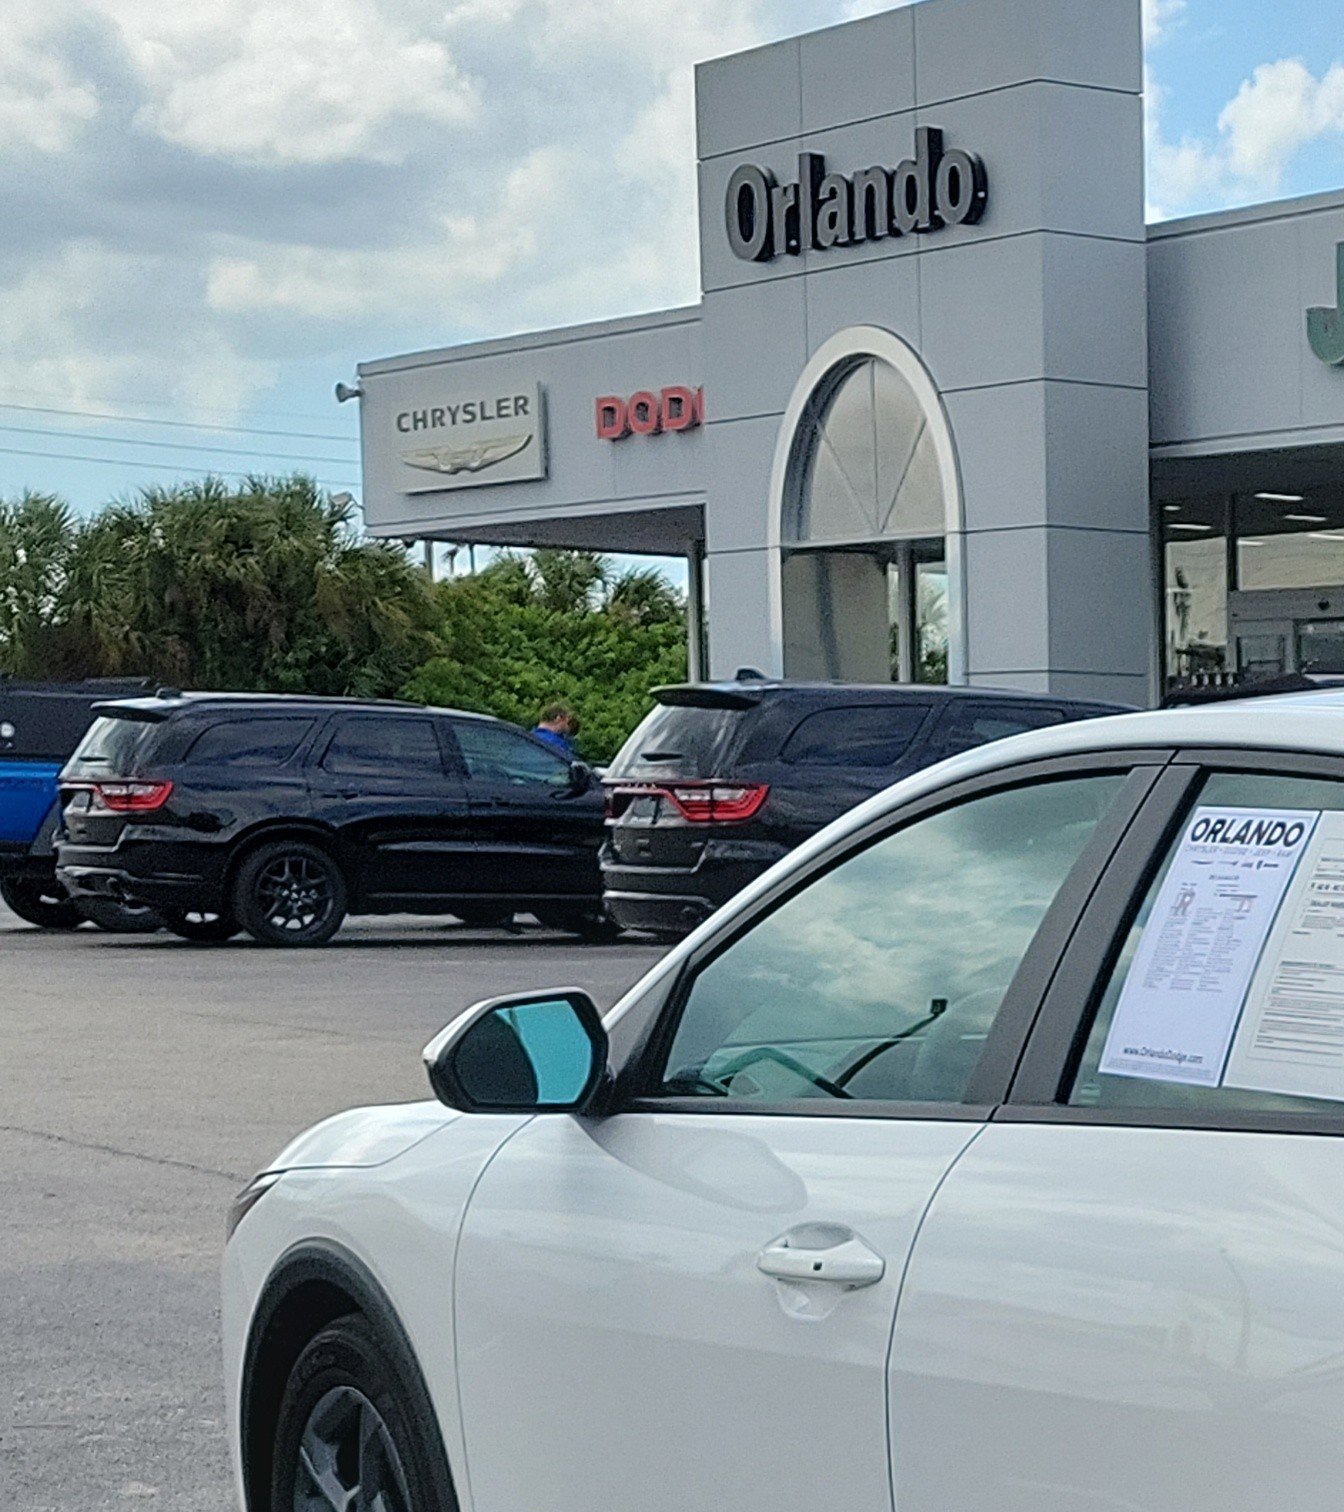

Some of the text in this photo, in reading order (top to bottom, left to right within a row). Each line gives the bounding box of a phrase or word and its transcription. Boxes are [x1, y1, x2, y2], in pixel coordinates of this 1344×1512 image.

[725, 126, 988, 262] Orlando
[396, 394, 530, 433] CHRYSLER
[596, 384, 704, 442] DOD
[1191, 817, 1305, 848] ORLANDO
